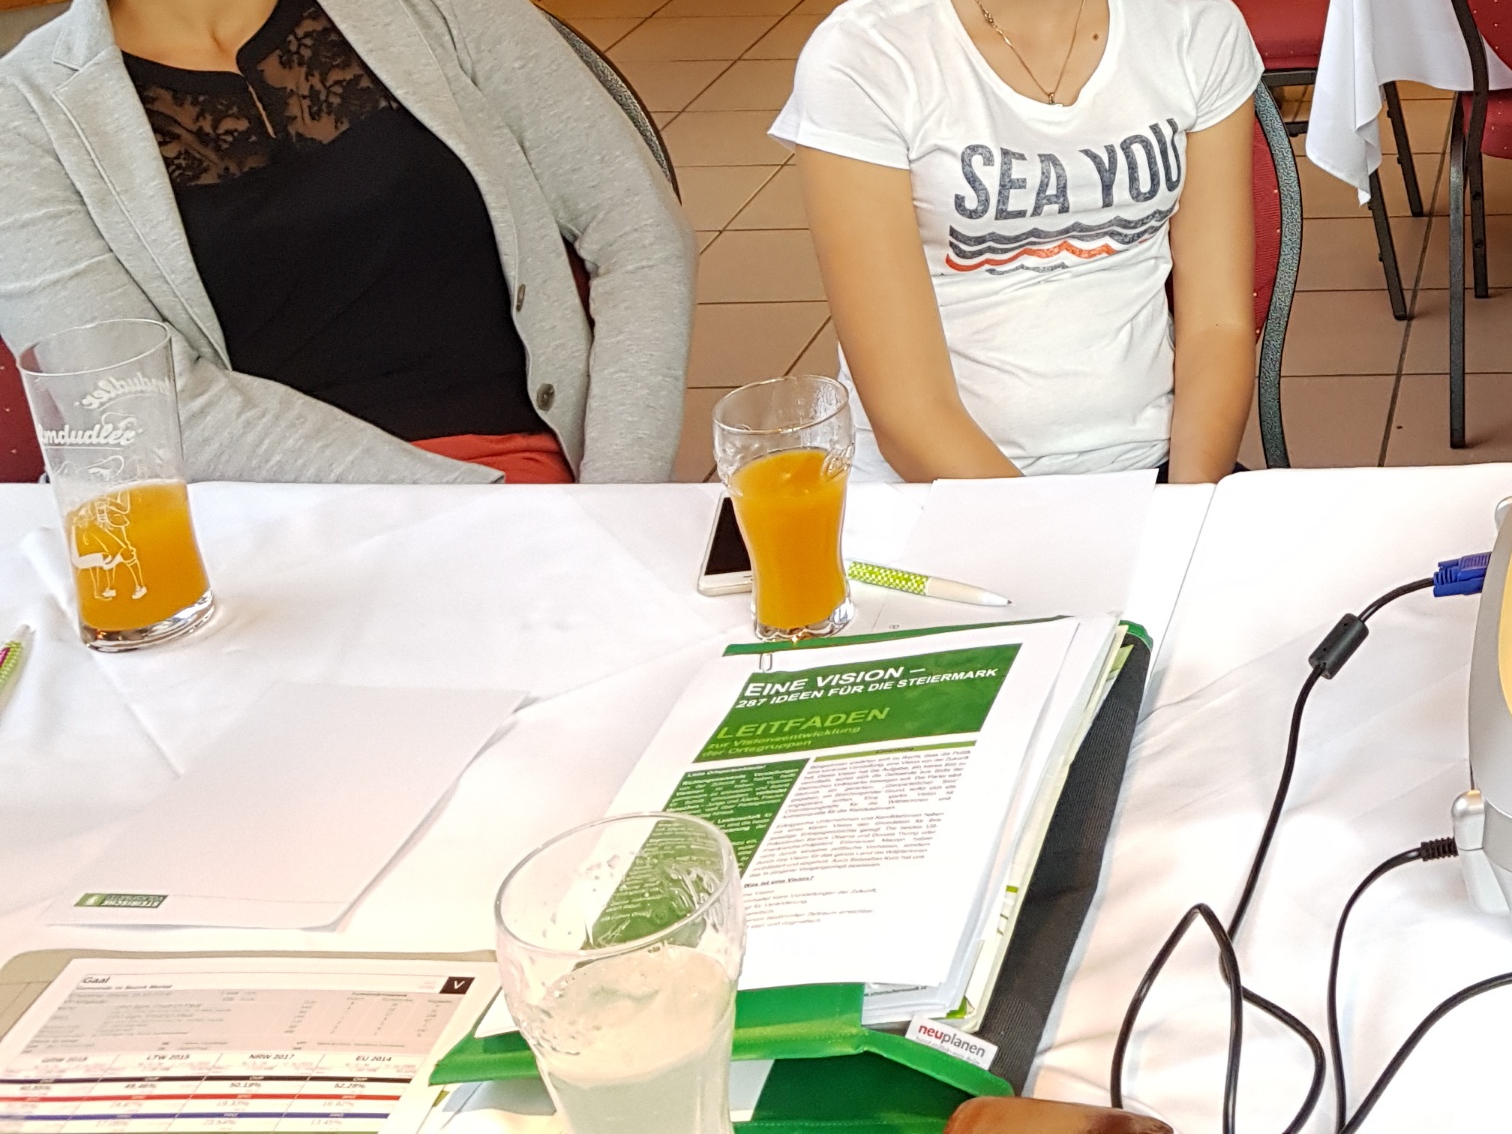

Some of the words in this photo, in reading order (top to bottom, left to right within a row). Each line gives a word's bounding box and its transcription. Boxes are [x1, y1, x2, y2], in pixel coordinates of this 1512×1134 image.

[954, 144, 1070, 221] SEA
[1079, 118, 1182, 209] YOU
[735, 698, 768, 708] 287
[769, 689, 824, 705] IDEEN
[827, 685, 864, 697] FÜR
[867, 681, 895, 692] DIE
[896, 668, 999, 689] STEIERMARK
[744, 678, 809, 697] EINE
[815, 666, 905, 688] VISION
[706, 741, 729, 750] zur
[733, 726, 861, 748] Visionsentwicklung
[716, 707, 890, 739] LEITFADEN
[702, 749, 723, 758] der
[82, 976, 111, 984] Gaal
[453, 980, 466, 990] V
[918, 1025, 986, 1058] neuplanen
